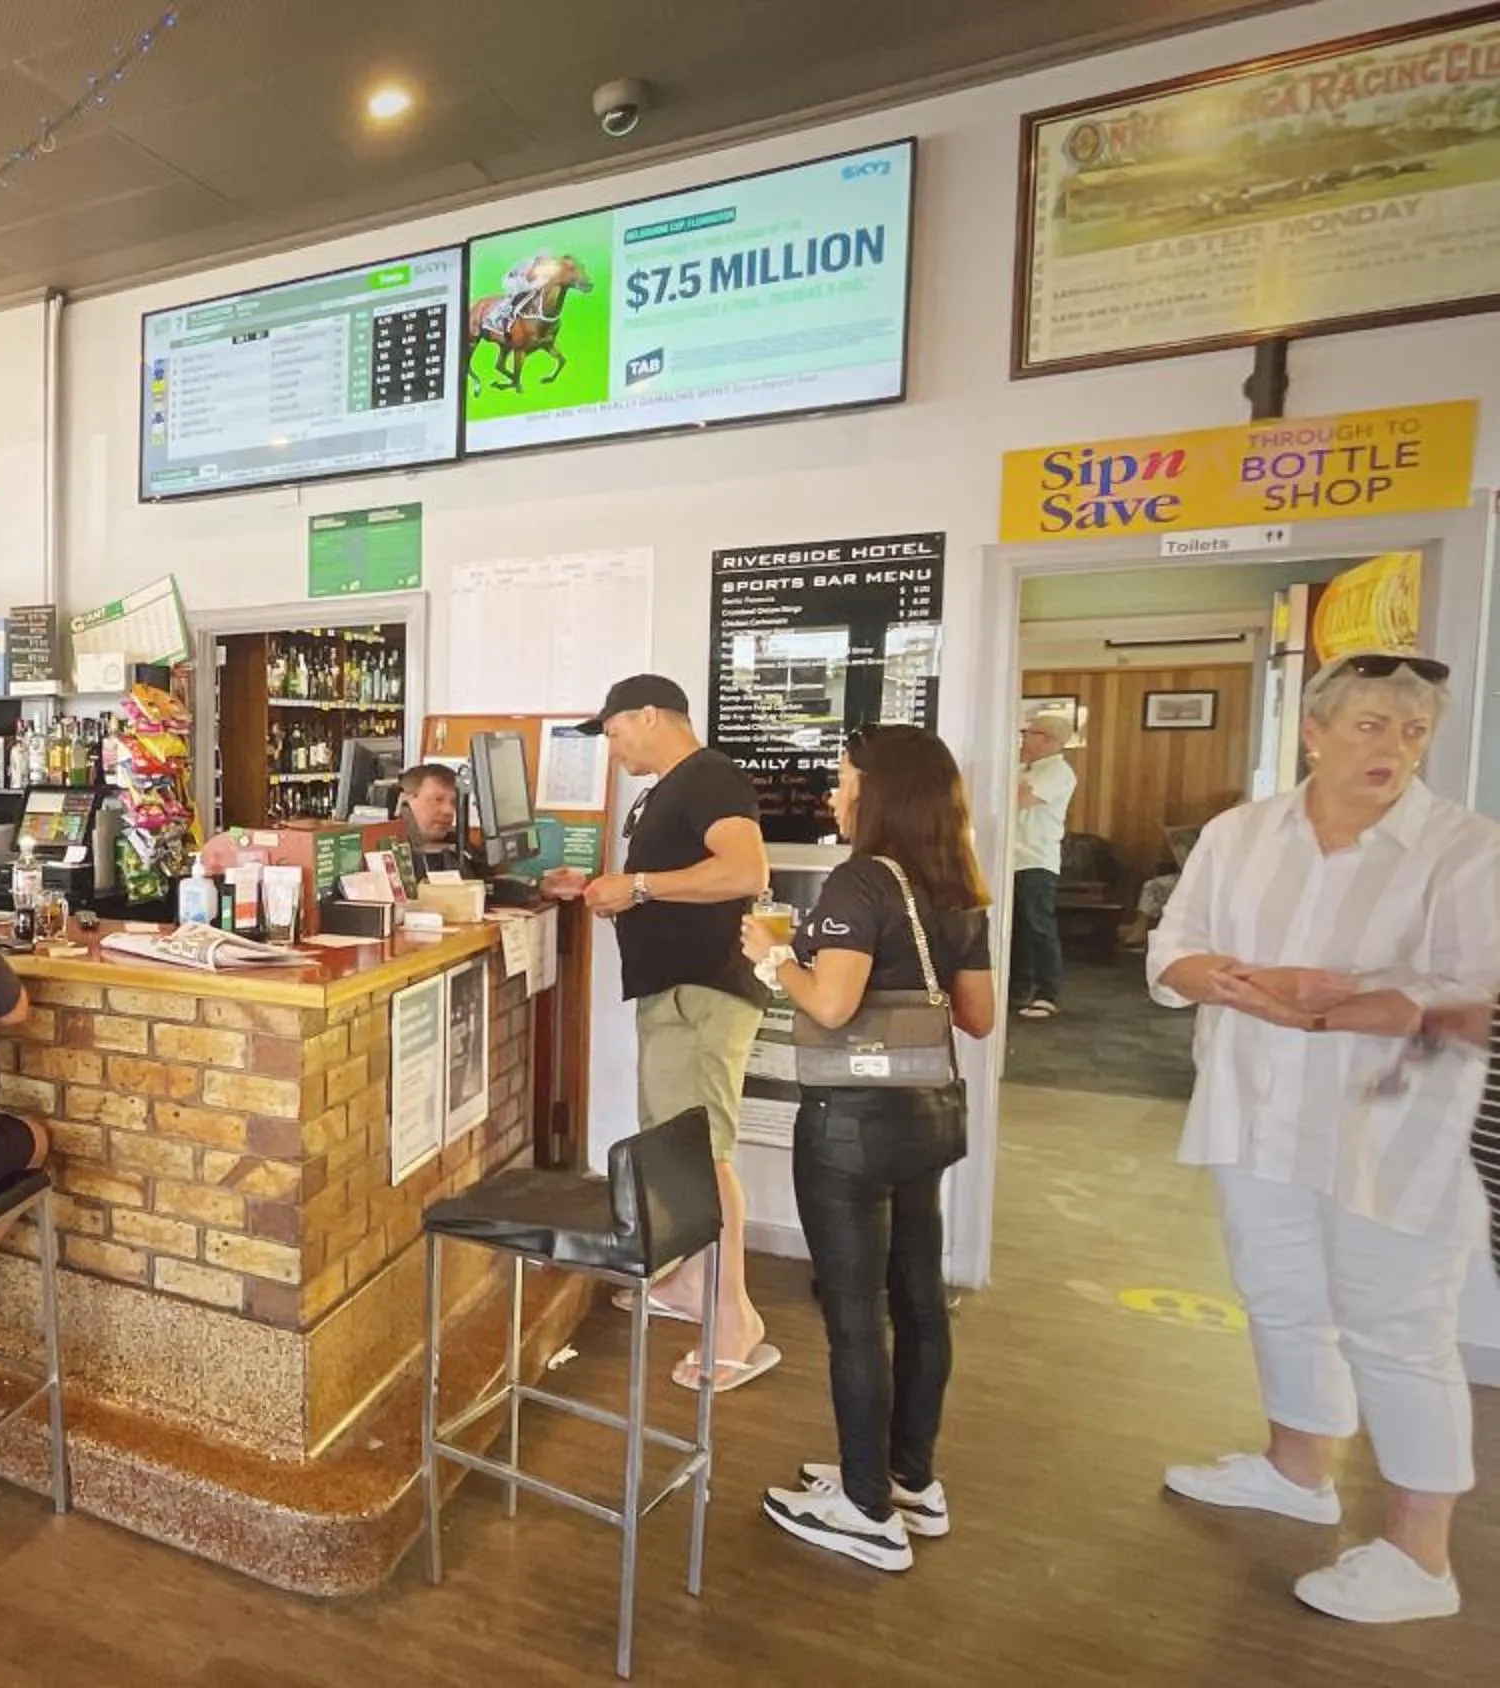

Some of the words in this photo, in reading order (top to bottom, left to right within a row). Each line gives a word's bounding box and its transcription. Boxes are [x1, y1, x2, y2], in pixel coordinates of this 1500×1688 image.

[1310, 57, 1437, 111] RACING
[1444, 42, 1500, 84] CLU
[1280, 197, 1422, 238] MONDAY
[625, 261, 702, 312] $7.5
[709, 225, 886, 294] MILLION
[630, 357, 661, 376] TAB
[1248, 422, 1374, 450] THROUGH
[1388, 417, 1422, 437] TO
[1241, 441, 1422, 483] BOTTLE
[1264, 477, 1393, 512] SHOP
[1040, 493, 1182, 533] Save
[722, 549, 841, 569] RIVERSIDE
[851, 542, 933, 559] HOTEL
[1166, 537, 1230, 554] Toilets
[722, 577, 804, 593] SPORTS
[813, 573, 857, 587] BAR
[865, 568, 932, 584] MENU
